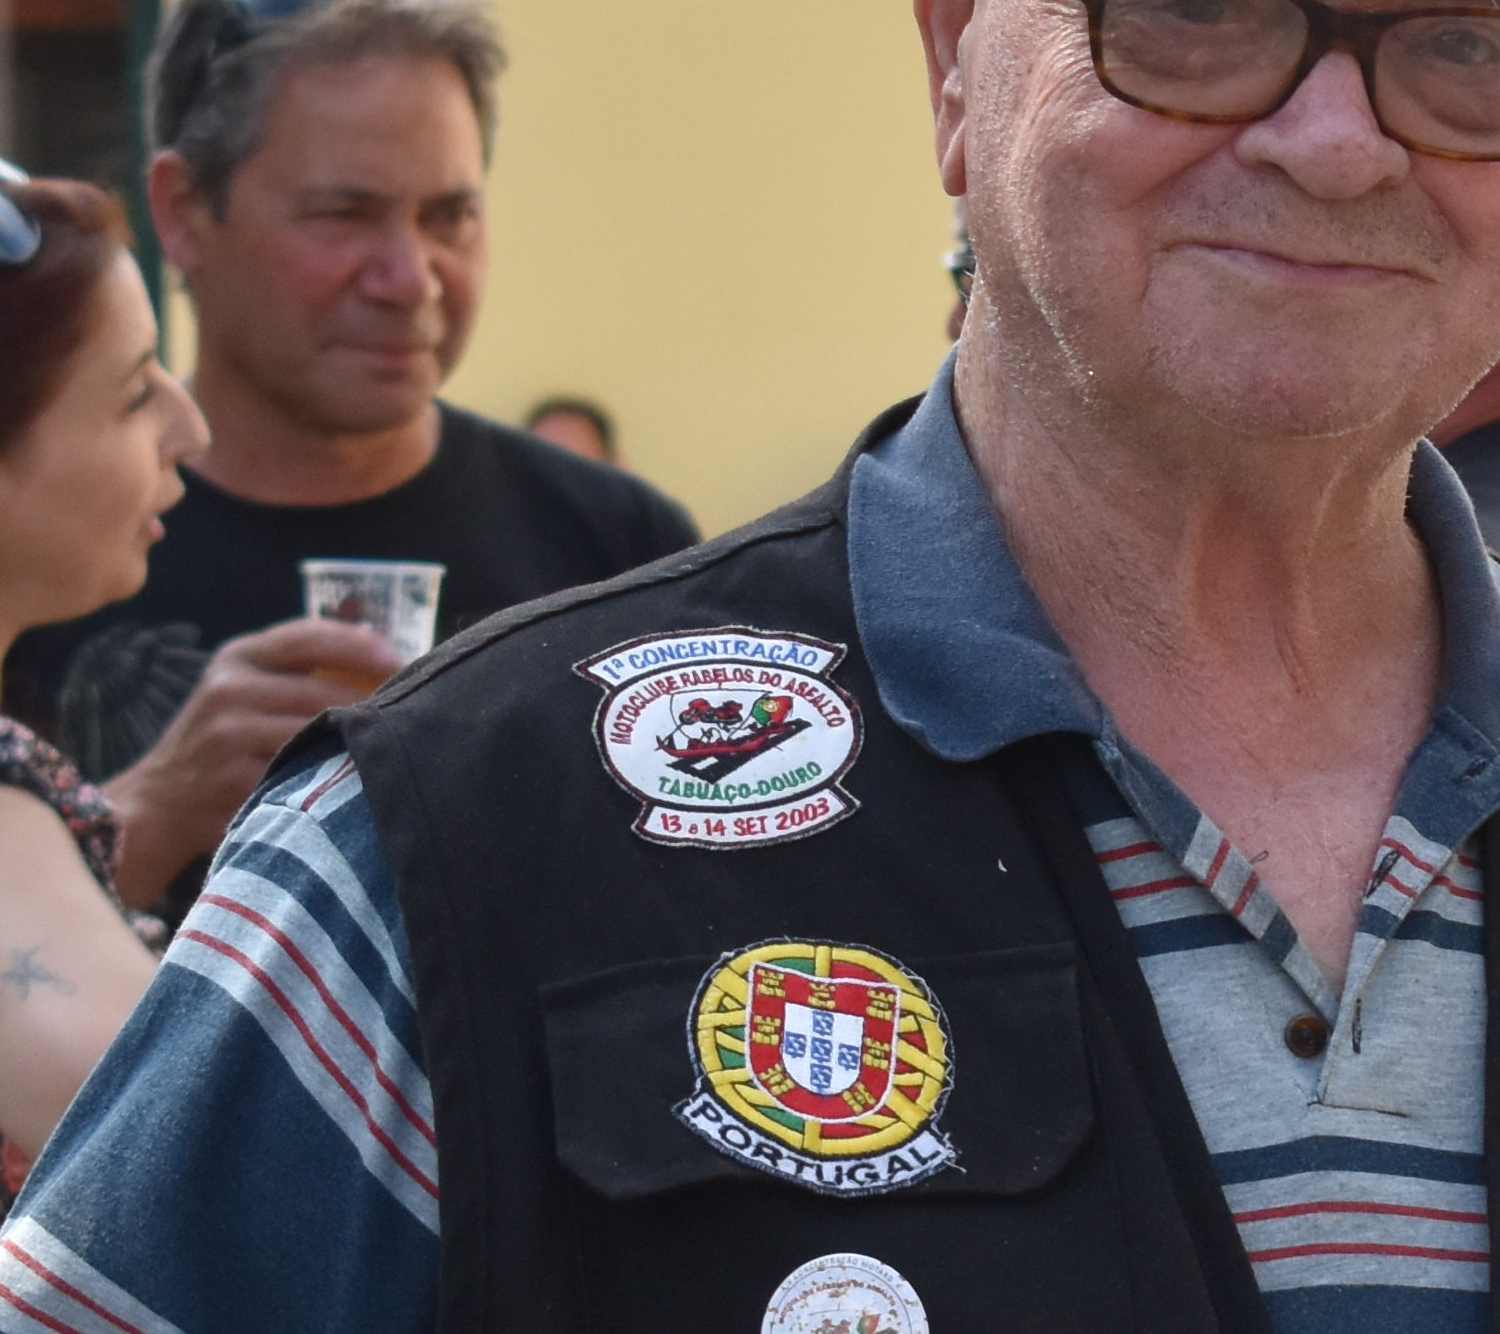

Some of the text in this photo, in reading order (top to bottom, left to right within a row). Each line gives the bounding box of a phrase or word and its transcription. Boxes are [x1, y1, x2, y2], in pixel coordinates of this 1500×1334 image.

[628, 638, 819, 670] CONCENTRAÇÃO
[610, 668, 846, 745] MOTOCLUBE RABELOS DO ASFALTO
[660, 812, 683, 834] 13
[703, 817, 727, 836] 14
[733, 816, 768, 836] SET
[775, 797, 831, 830] 2003
[688, 1105, 941, 1187] PORTUGAL
